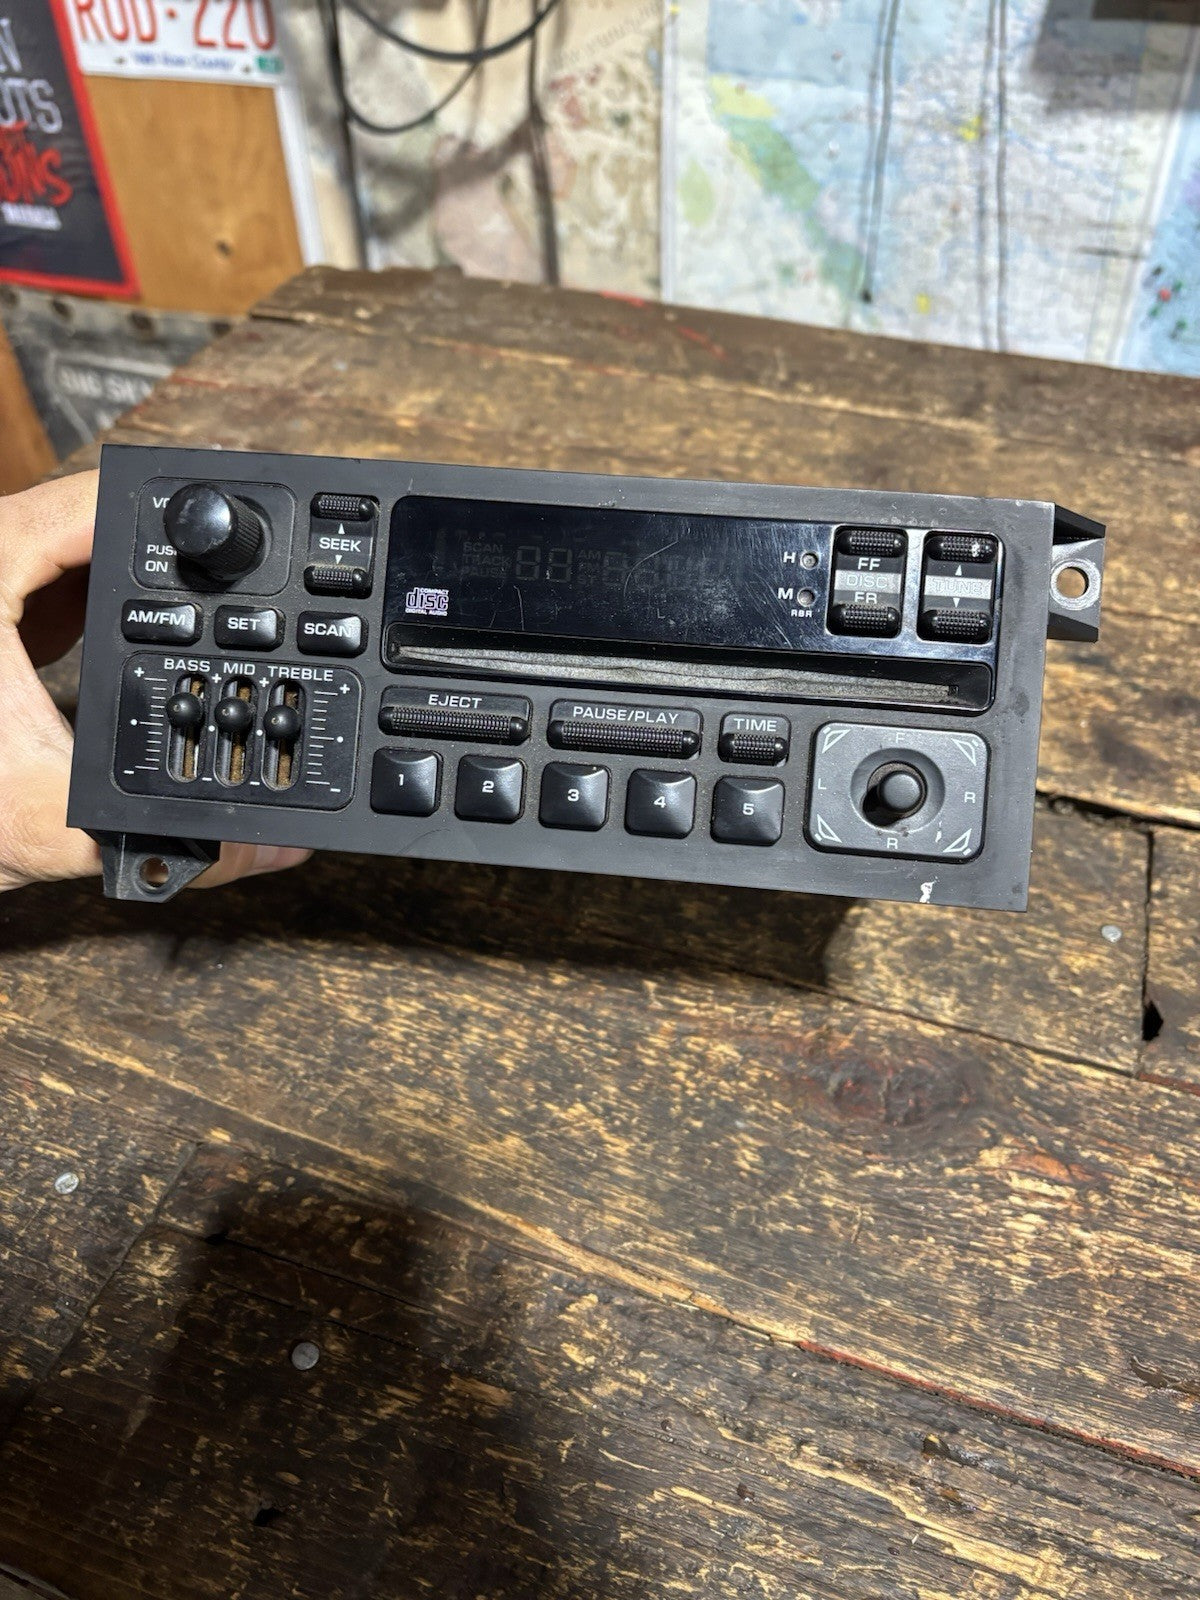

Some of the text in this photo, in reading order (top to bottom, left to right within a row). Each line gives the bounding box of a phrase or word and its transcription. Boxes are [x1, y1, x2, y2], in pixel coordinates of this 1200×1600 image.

[319, 537, 362, 553] SEEK
[782, 551, 796, 564] H
[857, 557, 881, 571] FF
[144, 560, 169, 573] ON
[846, 573, 888, 588] DISC
[934, 577, 983, 595] TUNE
[777, 587, 794, 600] M
[854, 591, 878, 604] FR
[126, 610, 186, 626] AM/FM
[790, 609, 813, 618] RBR
[227, 617, 261, 631] SET
[303, 622, 352, 638] SCAN
[163, 658, 211, 672] BASS
[223, 662, 256, 676] MID
[267, 665, 334, 682] TREBLE
[428, 693, 483, 709] EJECT
[572, 706, 680, 725] PAUSE/PLAY
[733, 717, 777, 733] TIME
[895, 732, 906, 744] F
[397, 773, 405, 787] 1
[482, 780, 494, 793] 2
[817, 778, 827, 790] L
[567, 788, 579, 802] 3
[653, 795, 666, 809] 4
[964, 791, 976, 804] R
[742, 803, 754, 816] 5
[886, 837, 899, 850] R
